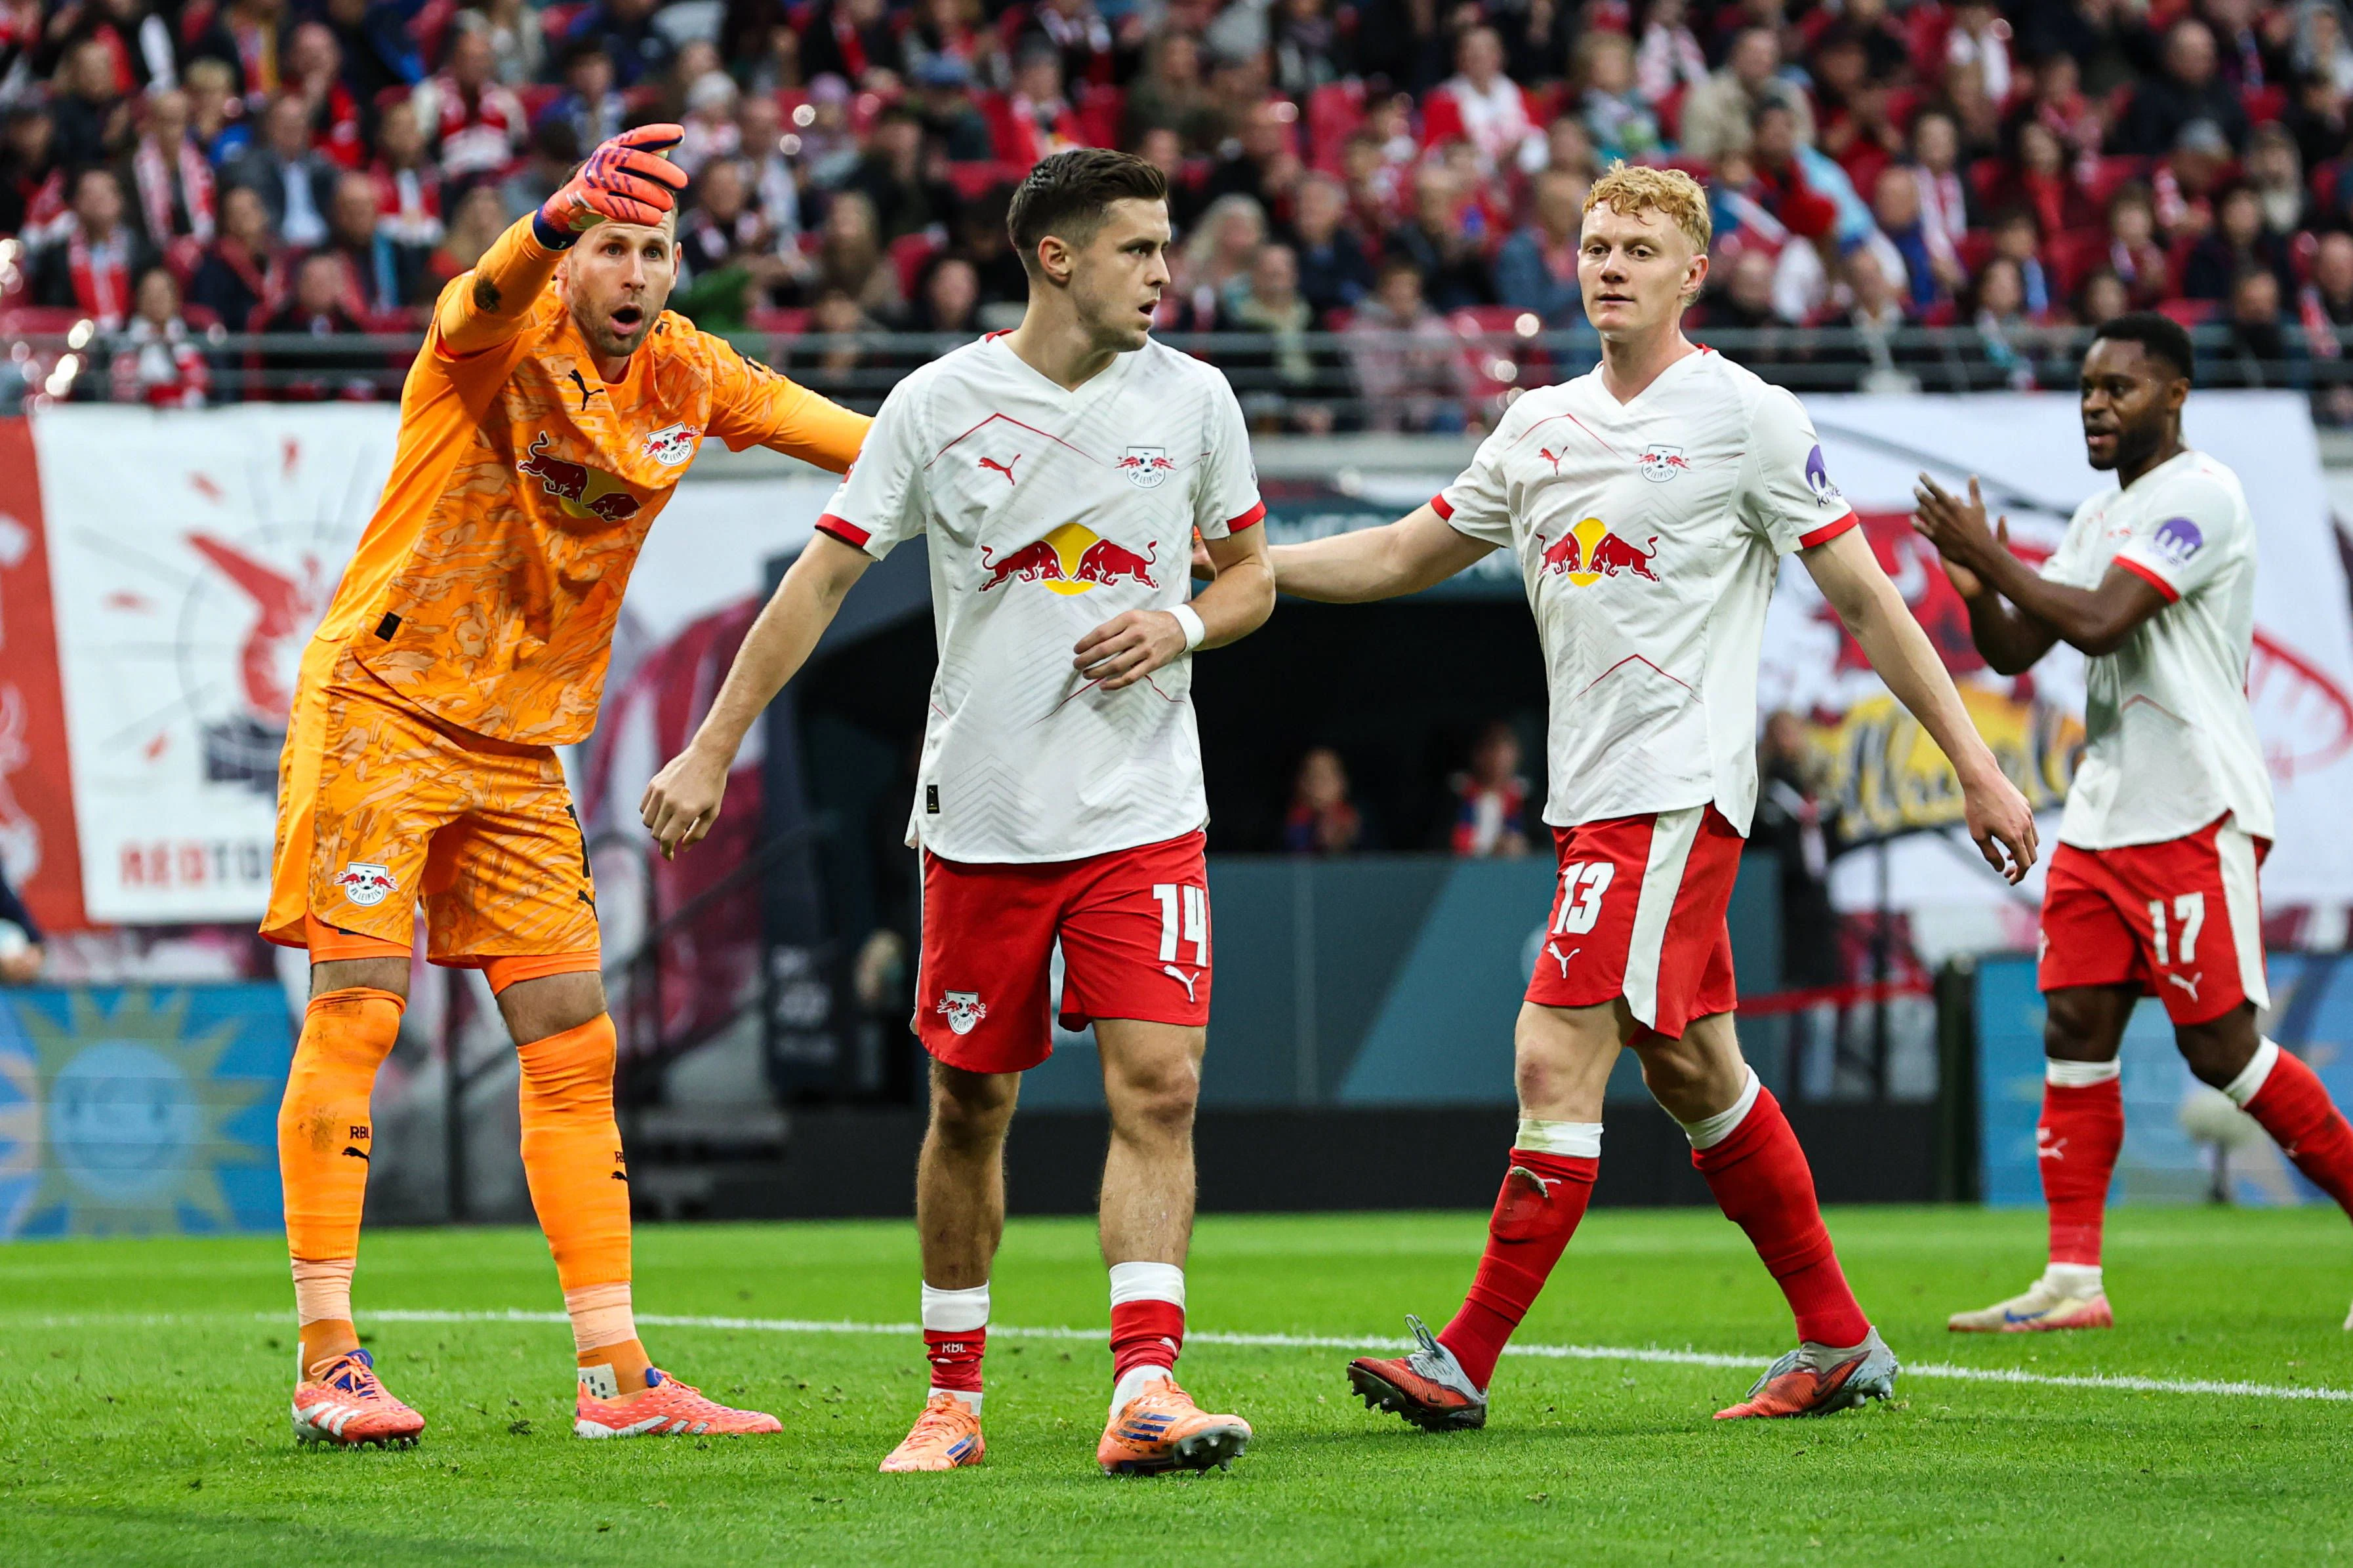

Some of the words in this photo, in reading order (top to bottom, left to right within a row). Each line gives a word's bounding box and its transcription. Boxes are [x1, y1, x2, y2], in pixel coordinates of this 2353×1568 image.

[1153, 883, 1207, 967] 14
[1551, 862, 1616, 934] 13
[2148, 892, 2205, 966] 17
[350, 1125, 370, 1140] RBL
